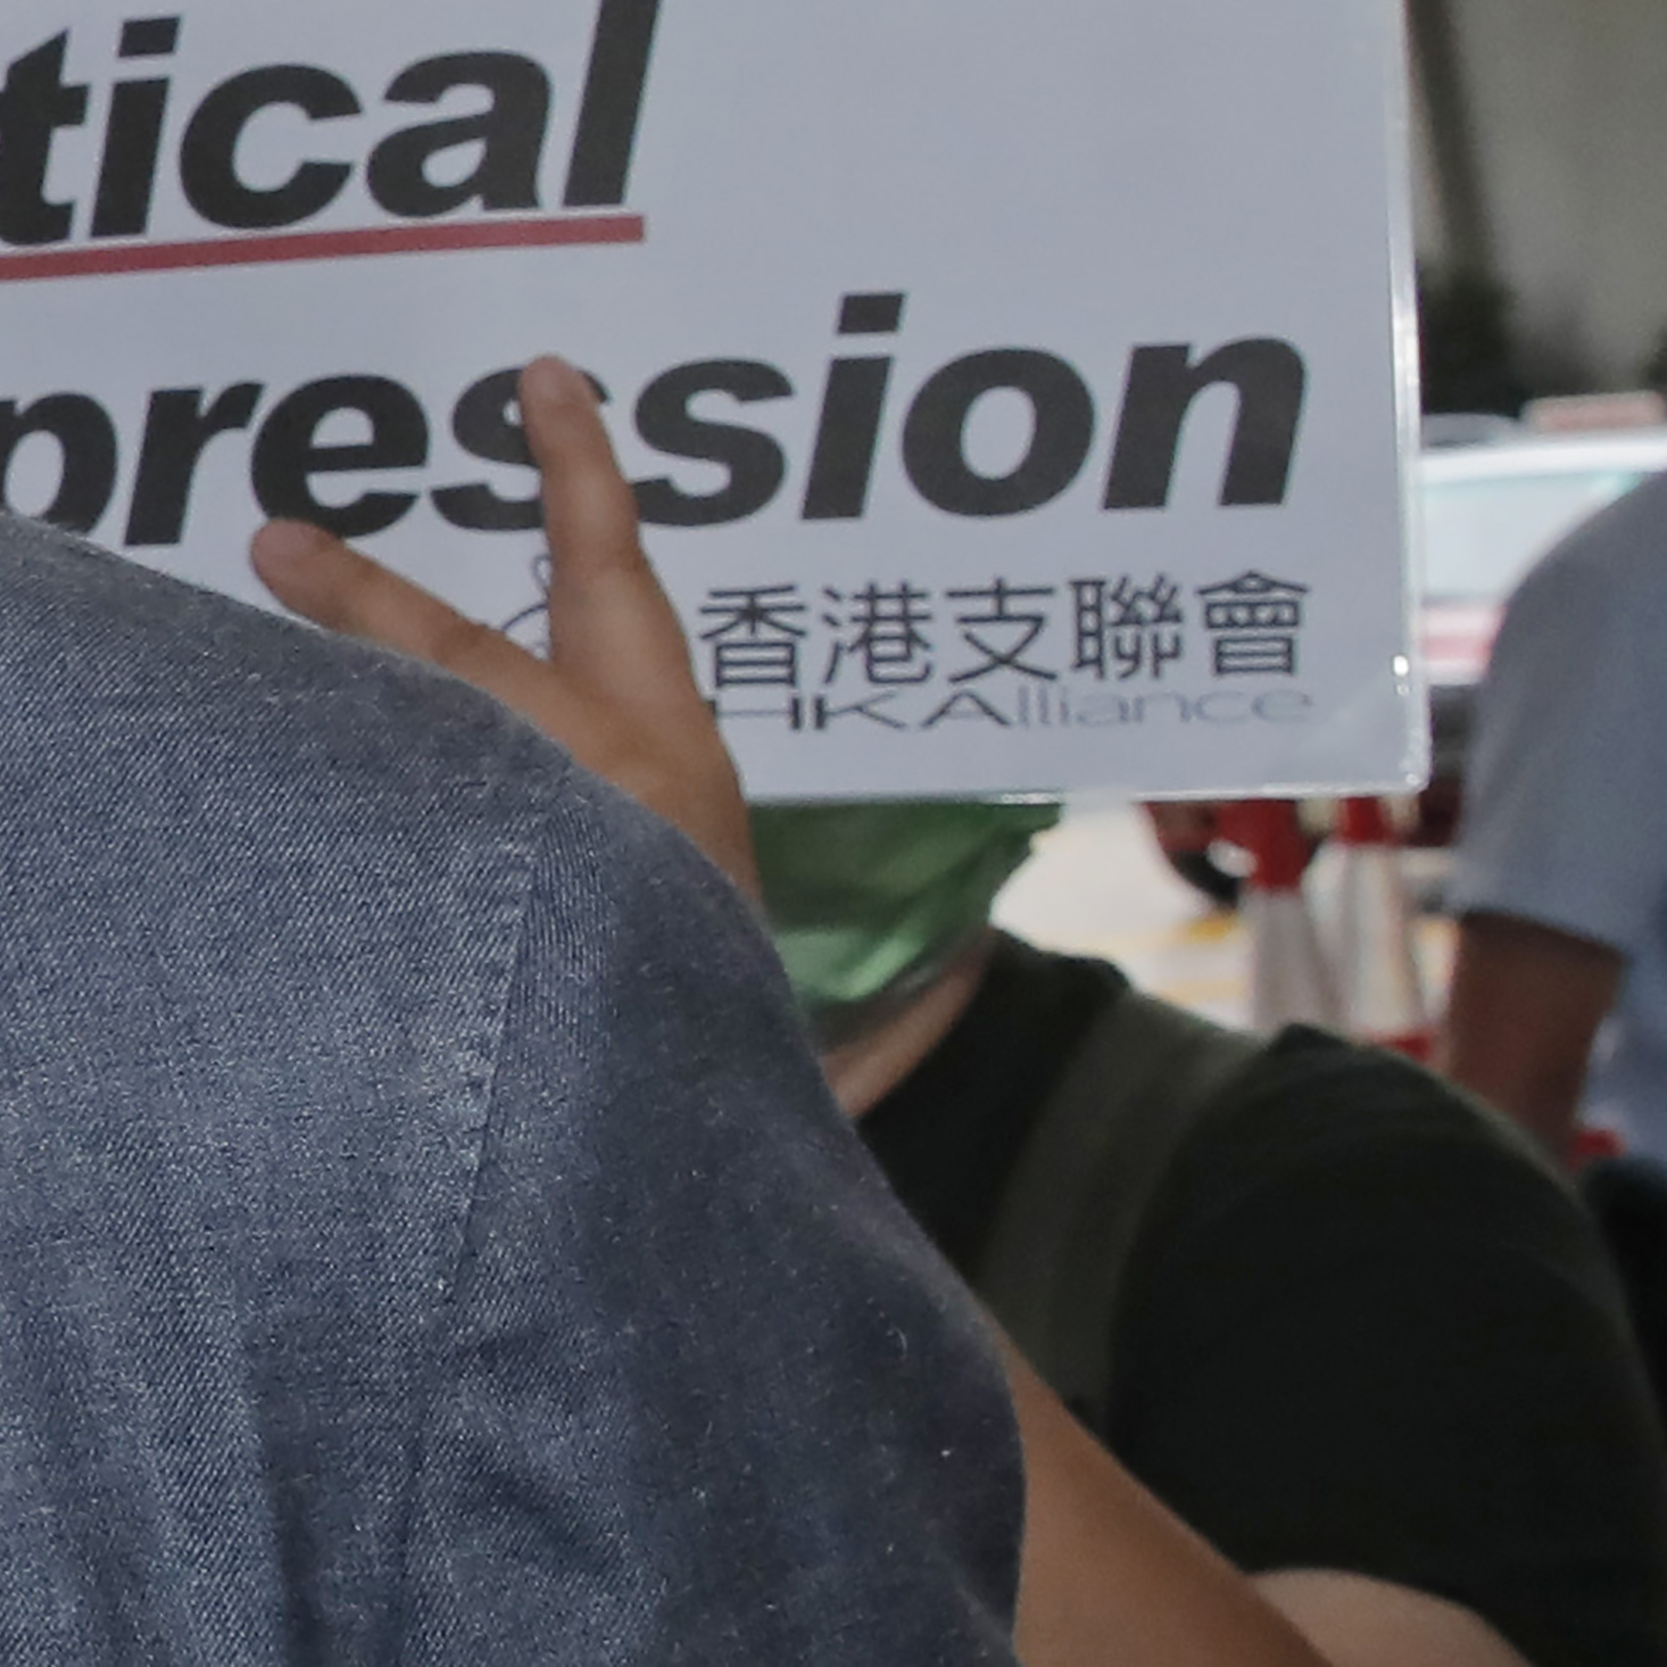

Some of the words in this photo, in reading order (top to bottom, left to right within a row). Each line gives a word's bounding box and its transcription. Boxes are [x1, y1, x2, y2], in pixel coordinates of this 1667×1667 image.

[697, 570, 1310, 689] 香港支聯會
[921, 684, 1315, 730] Alliance
